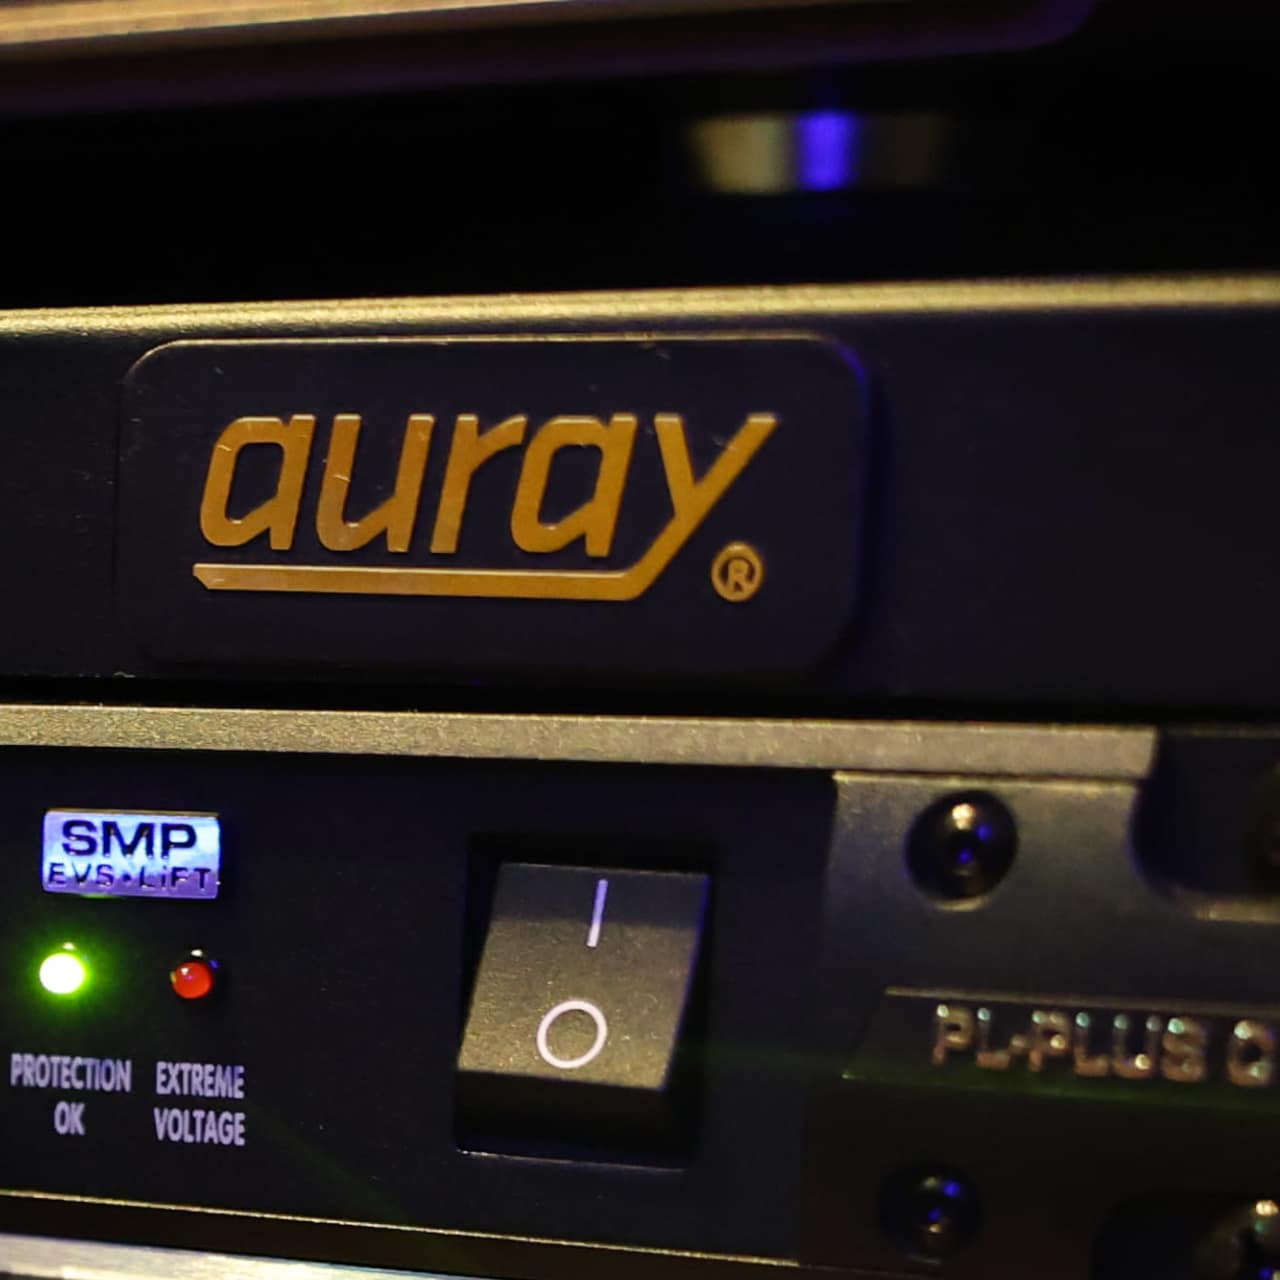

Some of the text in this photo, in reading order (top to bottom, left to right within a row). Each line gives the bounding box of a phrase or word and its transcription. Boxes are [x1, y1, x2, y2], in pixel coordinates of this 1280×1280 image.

[193, 412, 777, 600] auray
[61, 819, 197, 859] SMP
[10, 1053, 132, 1092] PROTECTION
[155, 1062, 246, 1099] EXTREME
[53, 1102, 86, 1135] OK
[153, 1108, 246, 1146] VOLTAGE
